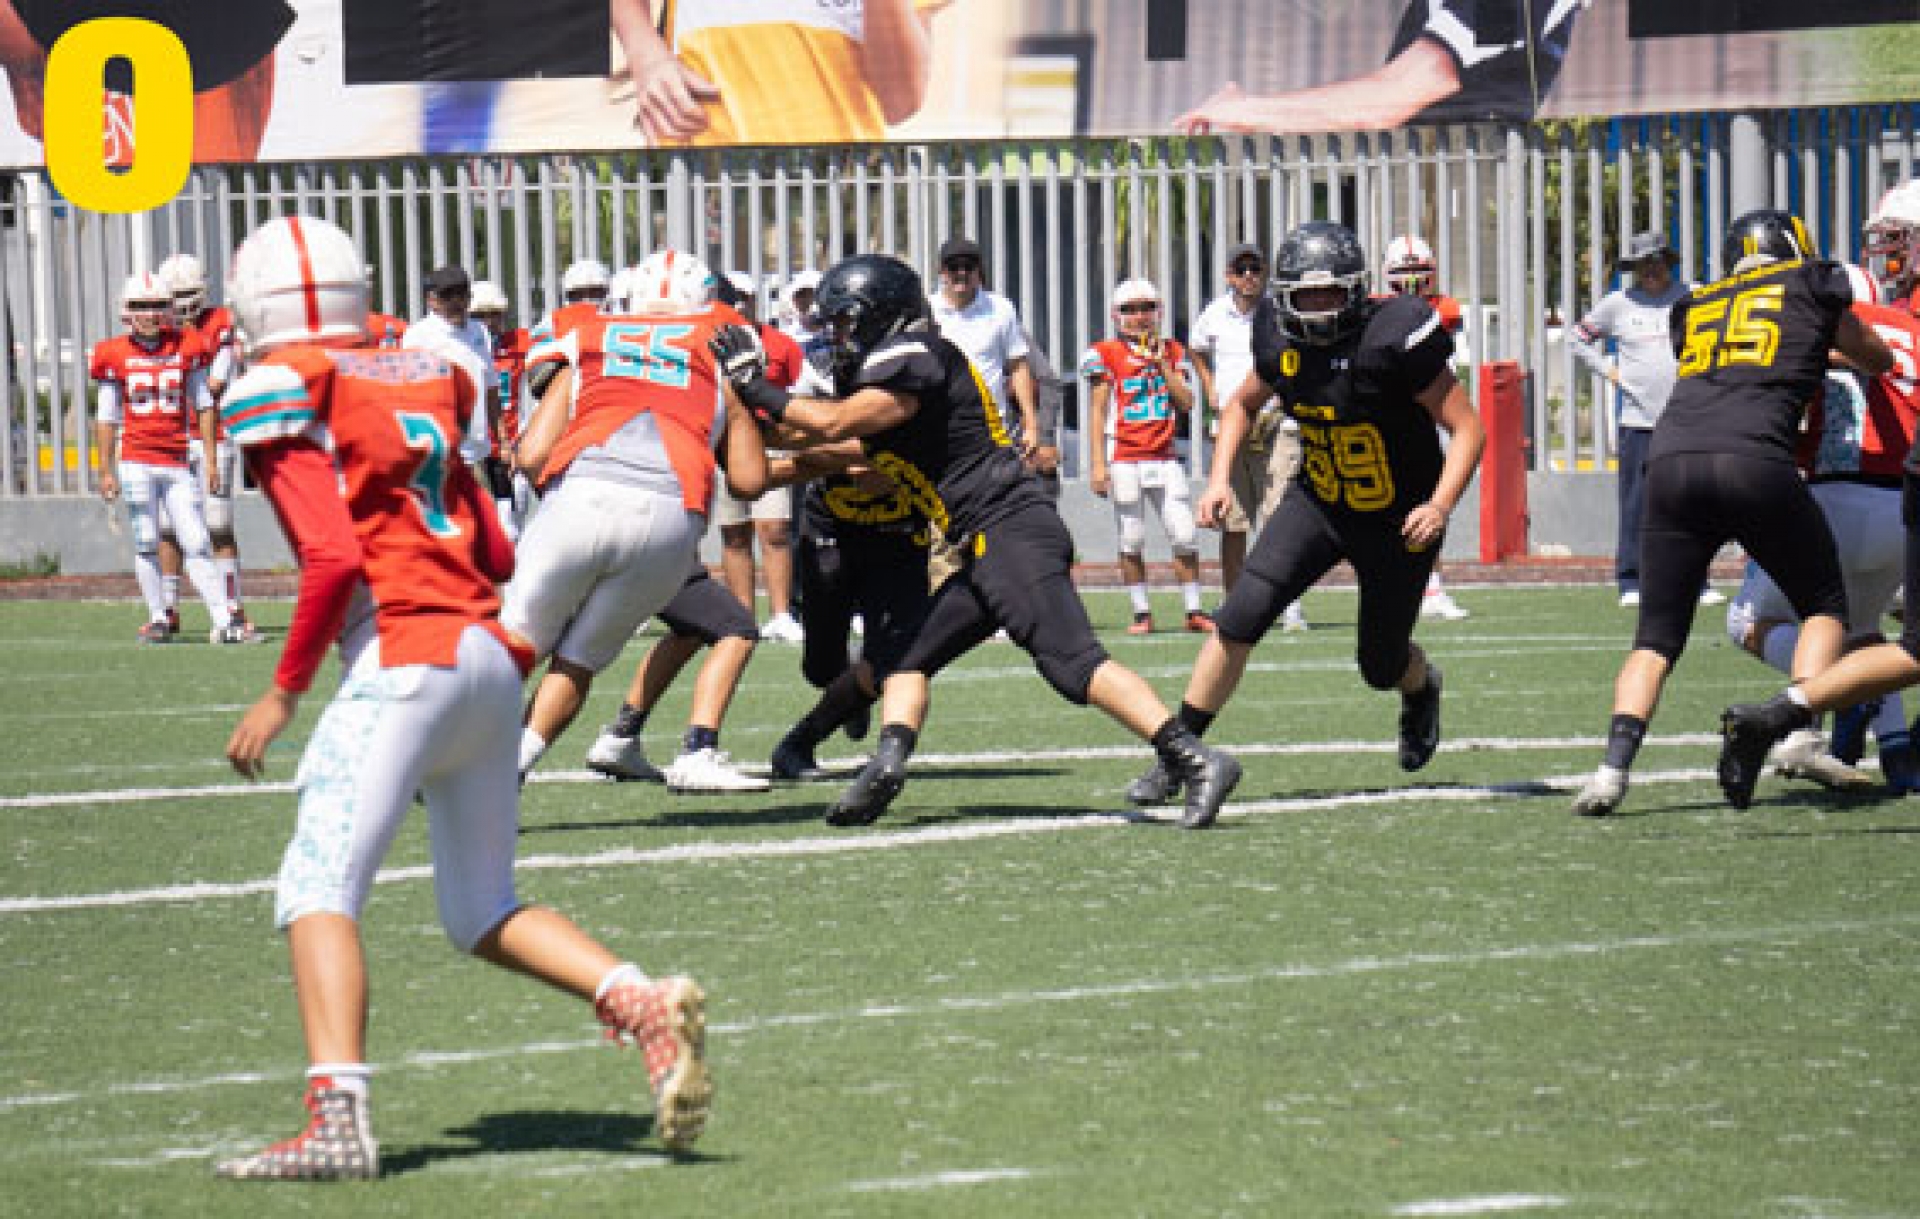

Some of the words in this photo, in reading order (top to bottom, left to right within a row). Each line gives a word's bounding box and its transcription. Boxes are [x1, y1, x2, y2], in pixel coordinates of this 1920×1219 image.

[602, 322, 694, 389] 55
[1679, 284, 1785, 377] 55
[394, 410, 462, 539] 7
